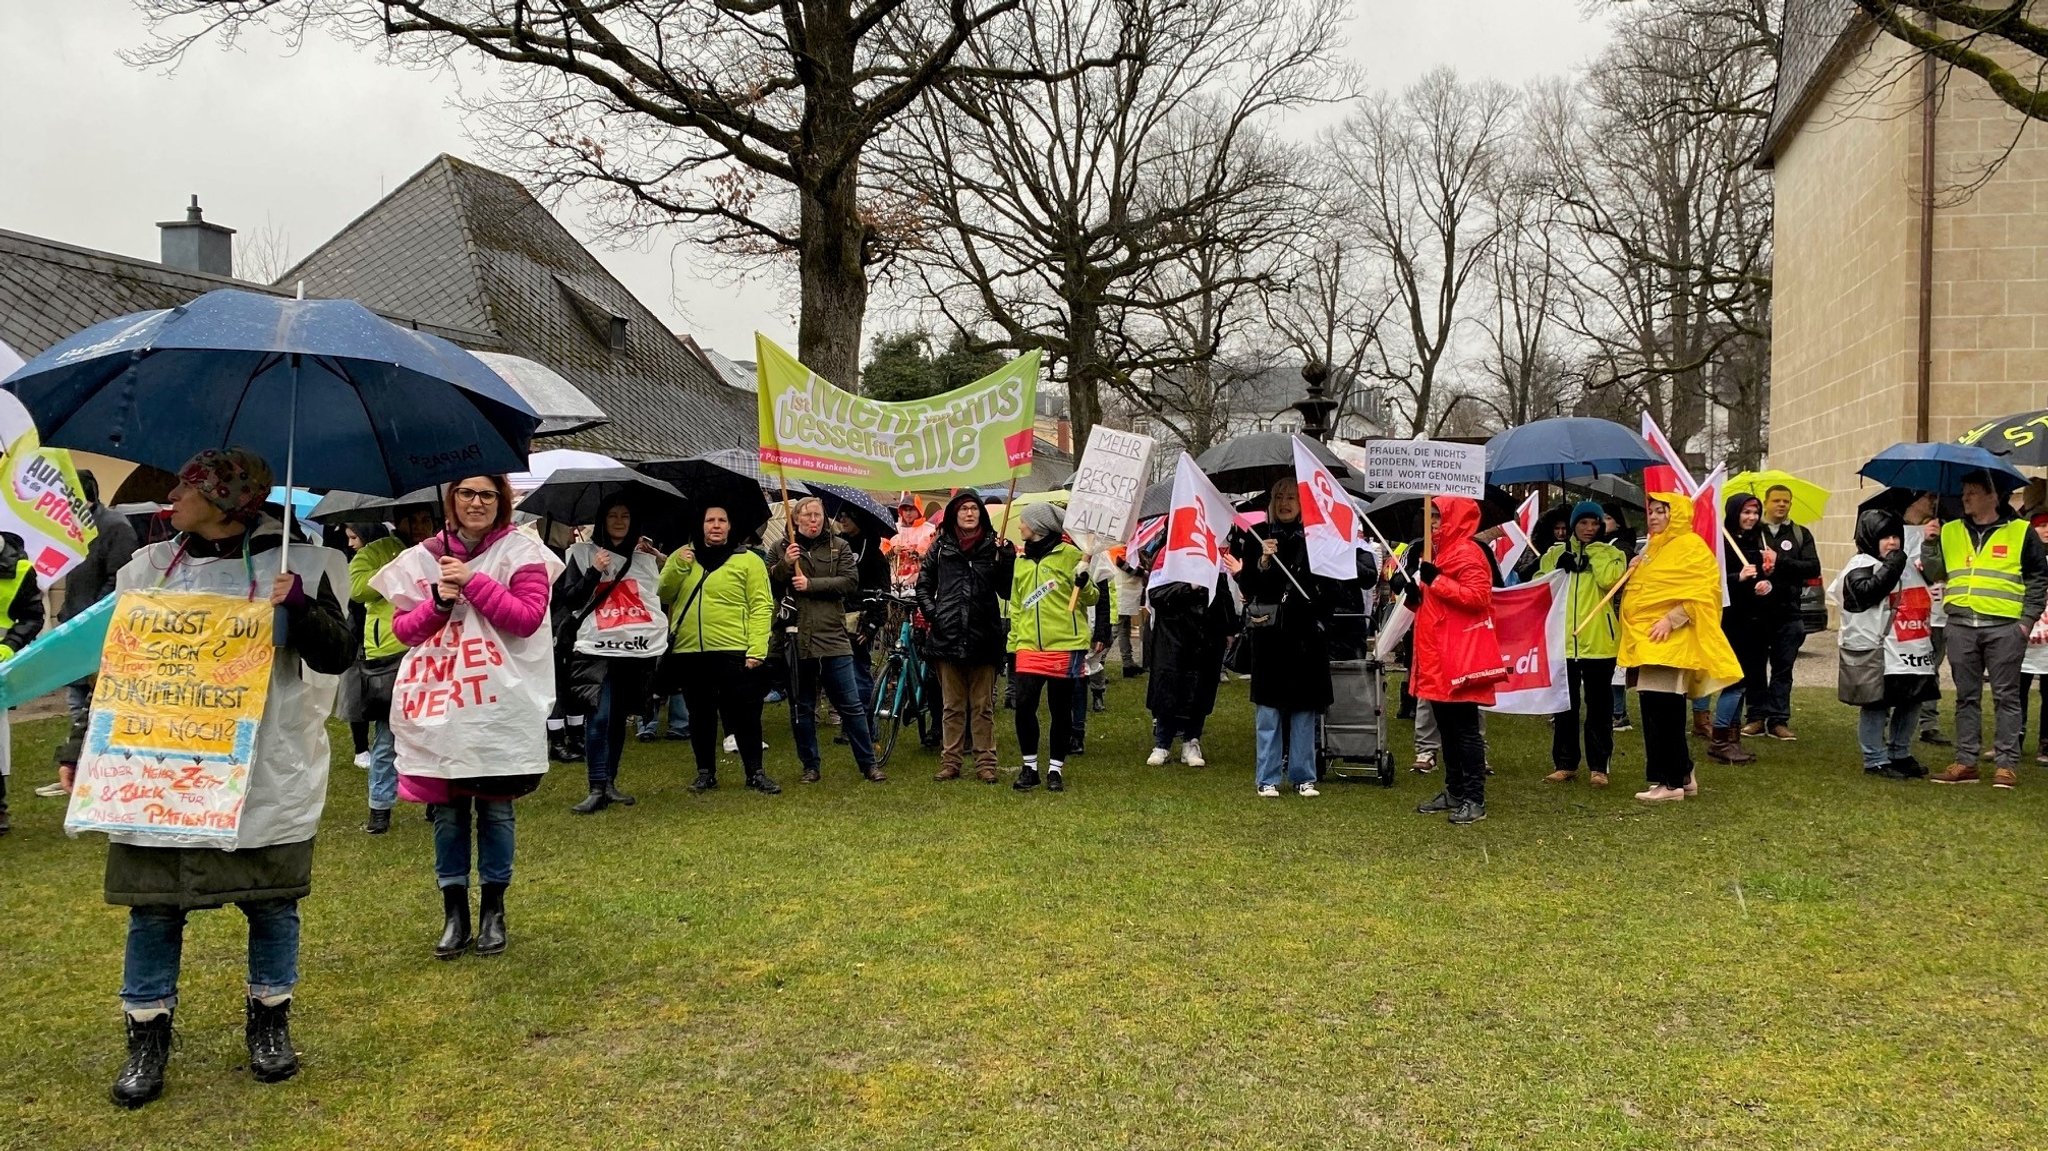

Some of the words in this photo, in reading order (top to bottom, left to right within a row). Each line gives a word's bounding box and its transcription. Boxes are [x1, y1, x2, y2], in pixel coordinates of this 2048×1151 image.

[790, 390, 810, 413] ist
[812, 375, 927, 434] Mehr
[949, 380, 1020, 428] uns
[779, 400, 876, 456] besser
[873, 440, 896, 457] für
[895, 423, 979, 472] alle
[1098, 432, 1142, 458] MEHR
[1369, 446, 1410, 457] FRAUEN,
[1414, 448, 1430, 457] DIE
[1434, 448, 1467, 459] NICHTS
[765, 451, 801, 466] Personal
[802, 457, 815, 467] ins
[1369, 458, 1418, 468] FORDERN,
[1422, 459, 1462, 470] WERDEN
[1078, 467, 1139, 502] BESSER
[1368, 480, 1384, 489] SIE
[1386, 481, 1440, 491] BEKOMMEN
[1445, 484, 1480, 495] NICHTS.
[1369, 468, 1394, 477] BEIM
[1398, 470, 1426, 479] WORT
[1429, 471, 1484, 485] GENOMMEN.
[1072, 510, 1121, 538] ALLE
[128, 606, 211, 635] PFLEGST
[226, 615, 260, 638] DU
[146, 640, 204, 661] SCHON
[156, 663, 197, 677] ODER
[402, 674, 498, 720] WERT.
[120, 716, 153, 736] DU
[168, 715, 237, 742] NOCH?
[100, 785, 118, 802] &
